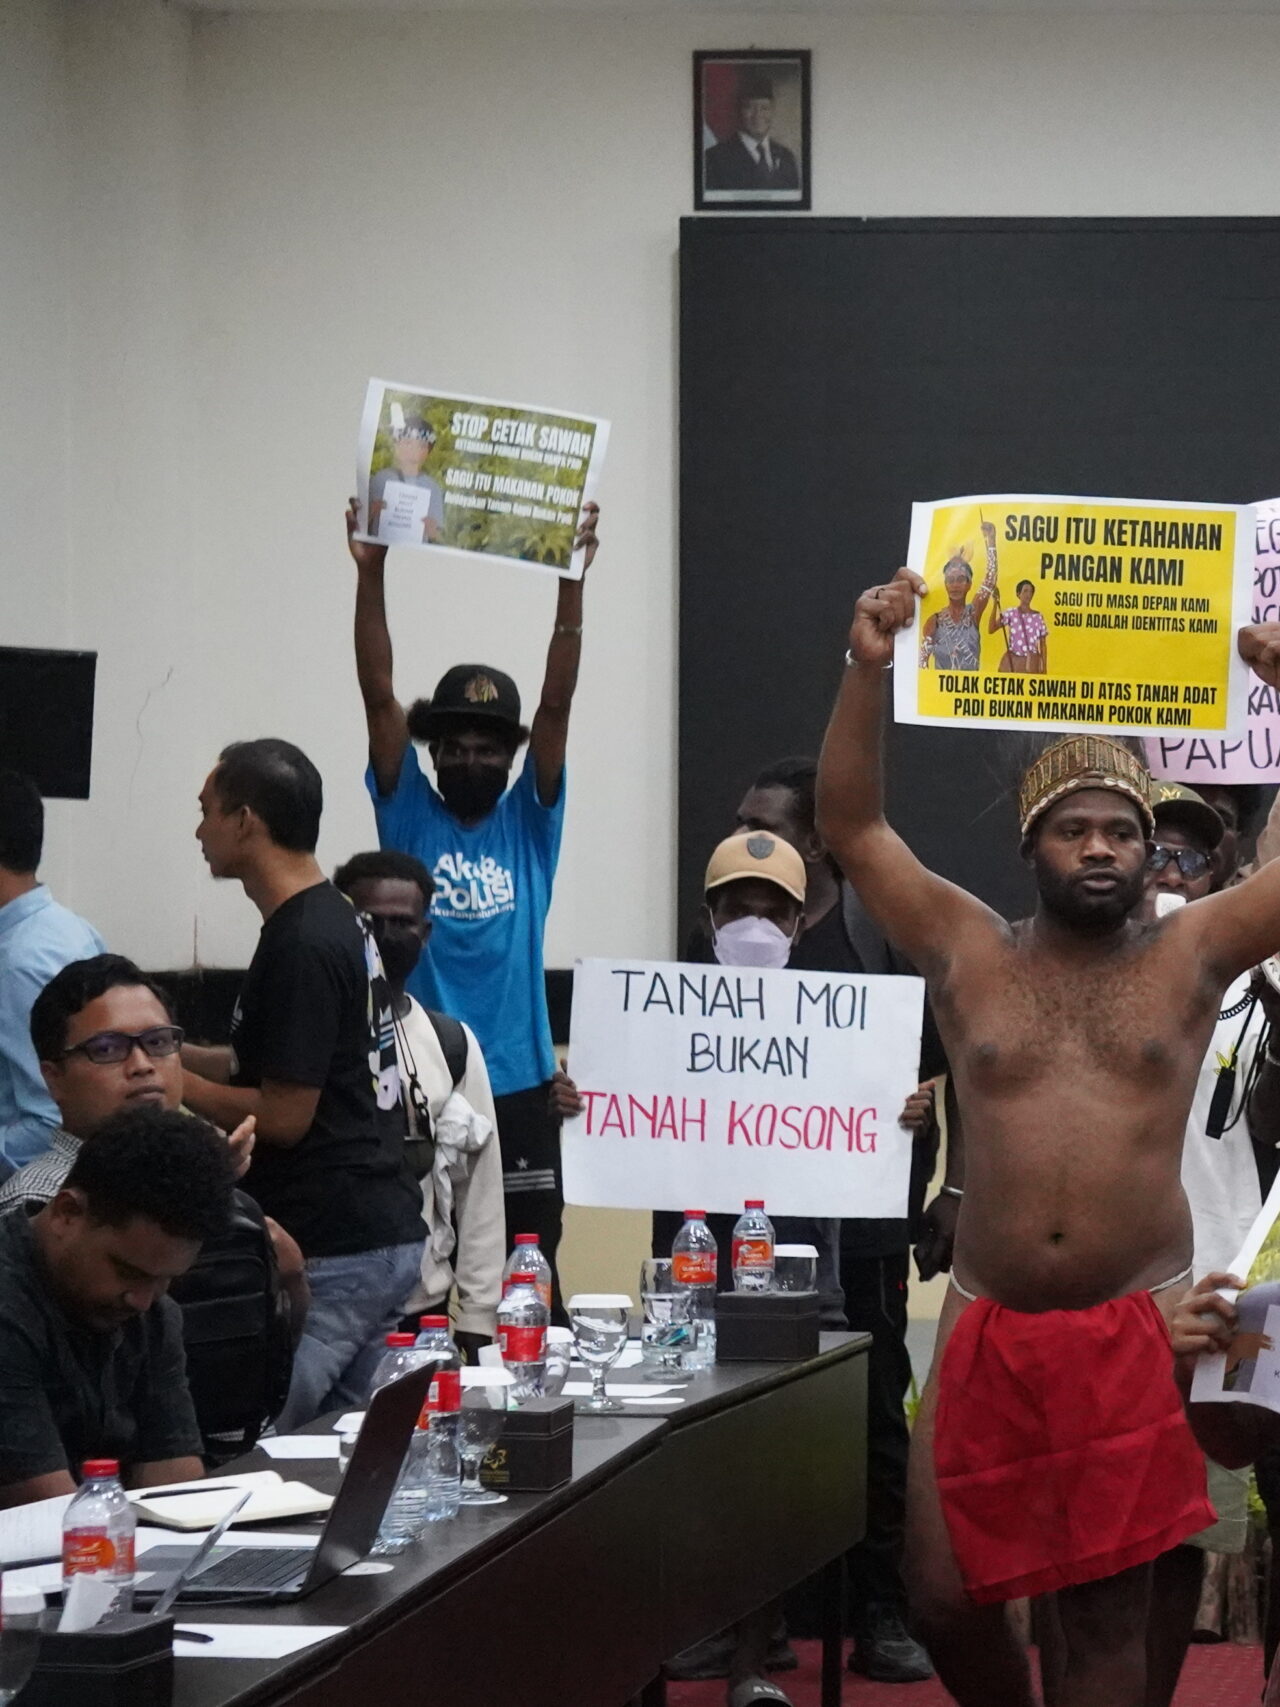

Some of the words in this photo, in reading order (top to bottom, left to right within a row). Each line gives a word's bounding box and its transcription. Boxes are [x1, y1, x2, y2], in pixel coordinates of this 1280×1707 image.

[452, 412, 488, 439] STOP
[491, 418, 537, 447] CETAK
[539, 425, 592, 457] SAWAH
[445, 467, 474, 489] SAGU
[474, 472, 492, 492] ITU
[492, 475, 545, 501] MAKANAN
[546, 486, 580, 508] POKOK
[1005, 514, 1059, 544] SAGU
[1066, 517, 1096, 545] ITU
[1103, 517, 1222, 551] KETAHANAN
[1040, 553, 1122, 585] PANGAN
[1130, 556, 1184, 587] KAMI
[1054, 591, 1083, 607] SAGU
[1085, 593, 1103, 608] ITU
[1106, 594, 1139, 610] MASA
[1142, 595, 1178, 612] DEPAN
[1180, 597, 1210, 613] KAMI
[1053, 612, 1083, 628] SAGU
[1085, 613, 1129, 630] ADALAH
[1131, 615, 1186, 633] IDENTITAS
[1188, 617, 1218, 634] KAMI
[938, 675, 979, 694] TOLAK
[983, 677, 1025, 696] CETAK
[1028, 679, 1077, 698] SAWAH
[1080, 681, 1095, 699] DI
[1098, 682, 1132, 701] ATAS
[1136, 683, 1179, 703] TANAH
[1183, 686, 1218, 705] ADAT
[953, 698, 985, 716] PADI
[988, 699, 1034, 719] BUKAN
[1037, 702, 1105, 722] MAKANAN
[1108, 705, 1152, 725] POKOK
[1156, 707, 1192, 726] KAMI
[611, 970, 765, 1020] TANAH
[796, 980, 867, 1030] MOI
[687, 1033, 809, 1079] BUKAN
[578, 1091, 706, 1142] TANAH
[727, 1100, 878, 1153] KOSONG
